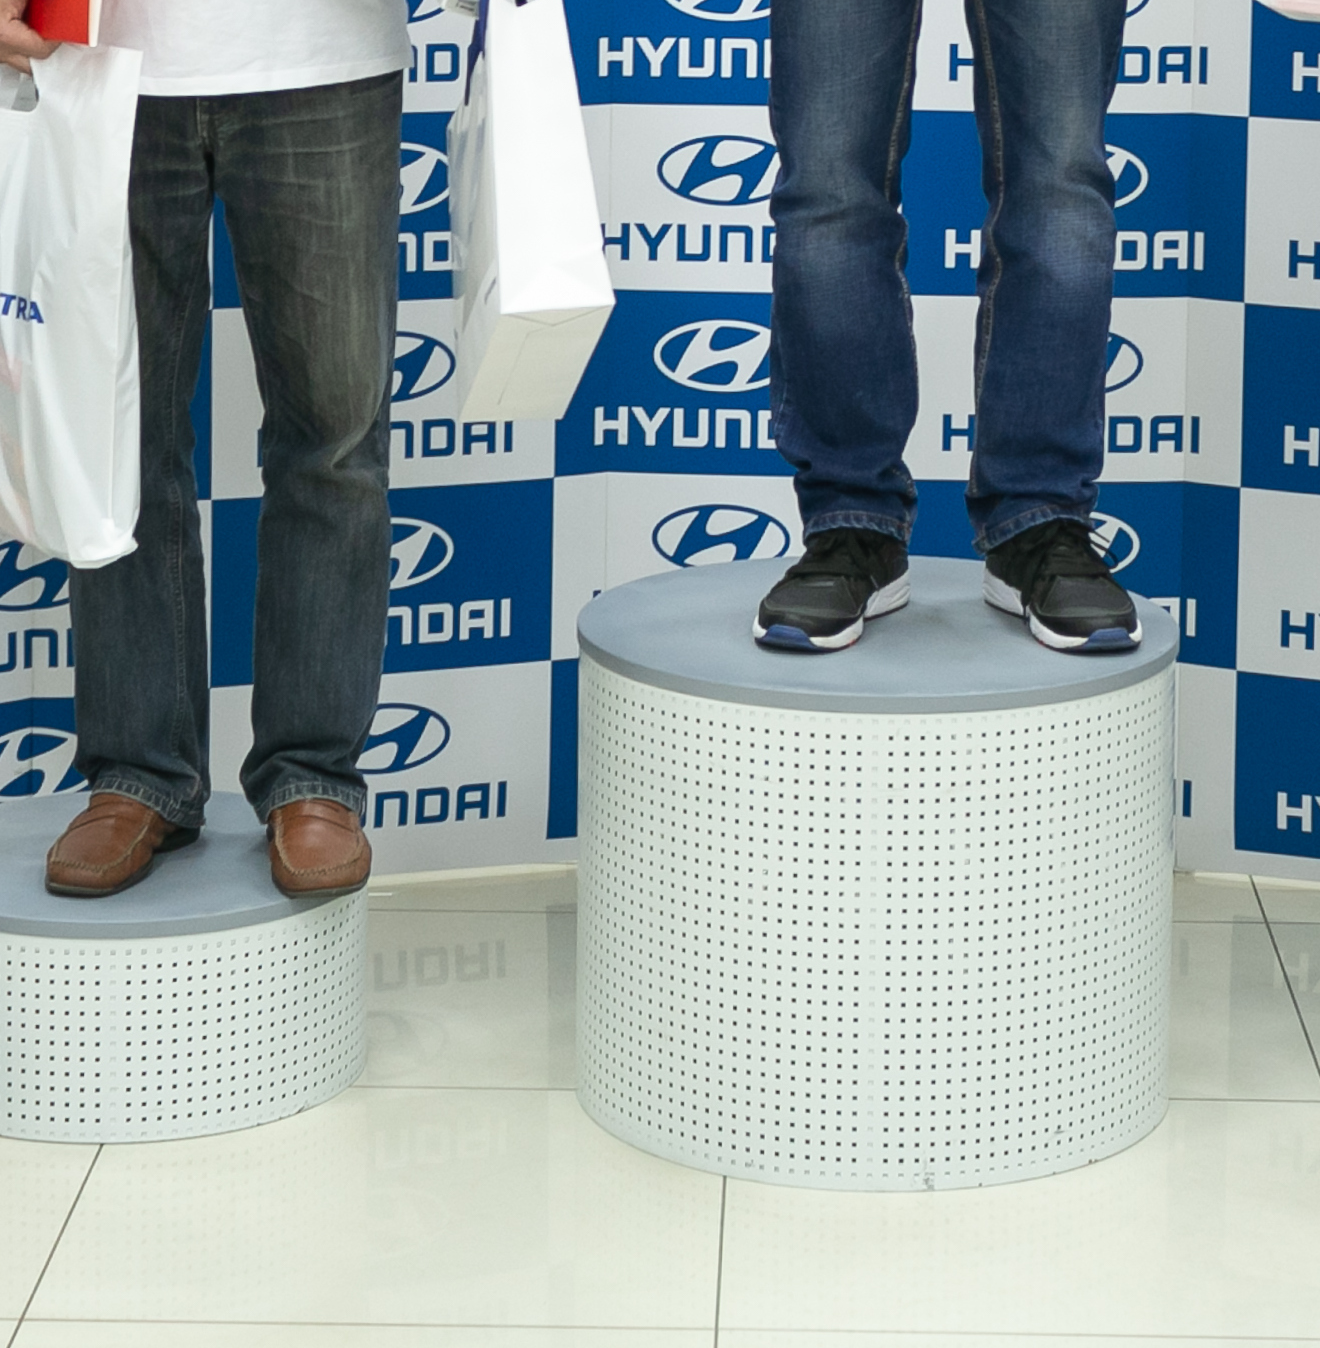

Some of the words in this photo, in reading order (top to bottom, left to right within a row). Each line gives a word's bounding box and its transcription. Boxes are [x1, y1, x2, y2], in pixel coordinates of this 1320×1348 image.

[598, 36, 771, 79] HYUN
[390, 419, 514, 460] NDAI
[386, 597, 512, 646] NDAI
[366, 781, 508, 830] NDAI
